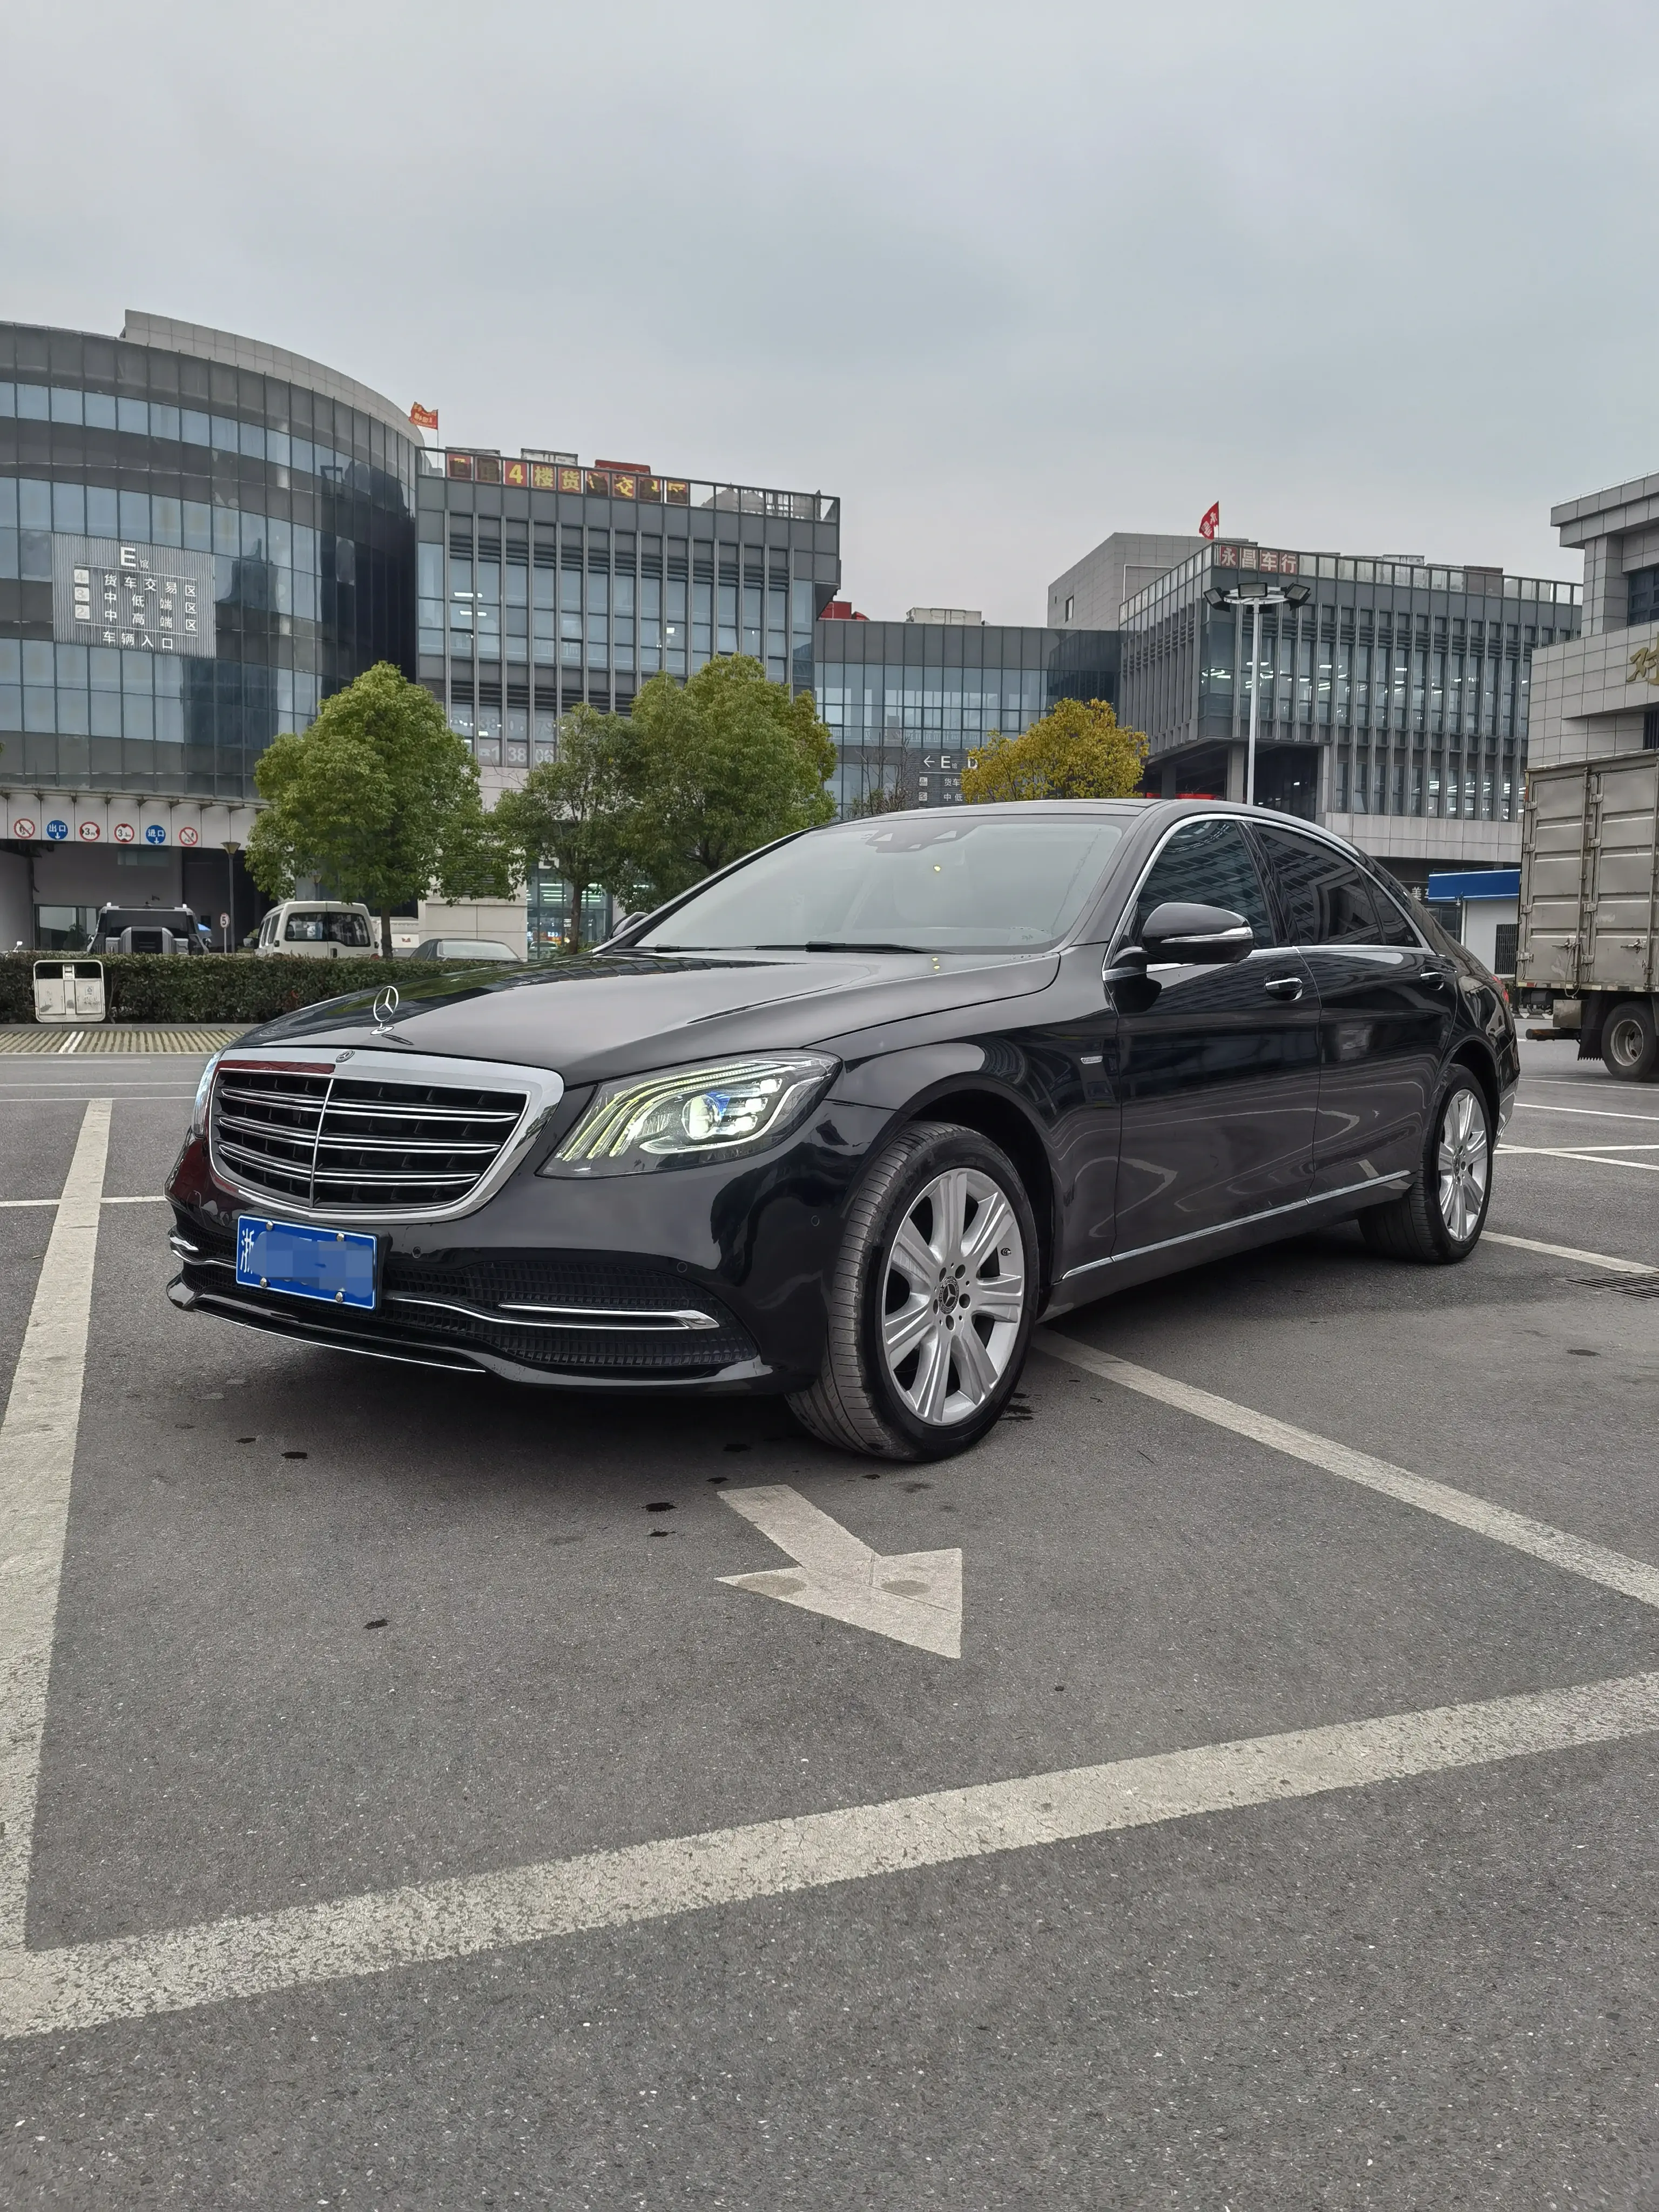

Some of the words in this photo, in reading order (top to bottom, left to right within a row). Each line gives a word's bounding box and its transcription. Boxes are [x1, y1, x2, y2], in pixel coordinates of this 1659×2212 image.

[1221, 547, 1297, 574] 永昌车行
[104, 574, 197, 597] 货车交易区
[104, 591, 197, 614] 中低端区
[104, 609, 197, 631] 中高端区
[103, 631, 173, 650] 车辆入口
[148, 828, 164, 837] 进口
[222, 916, 227, 926] 5
